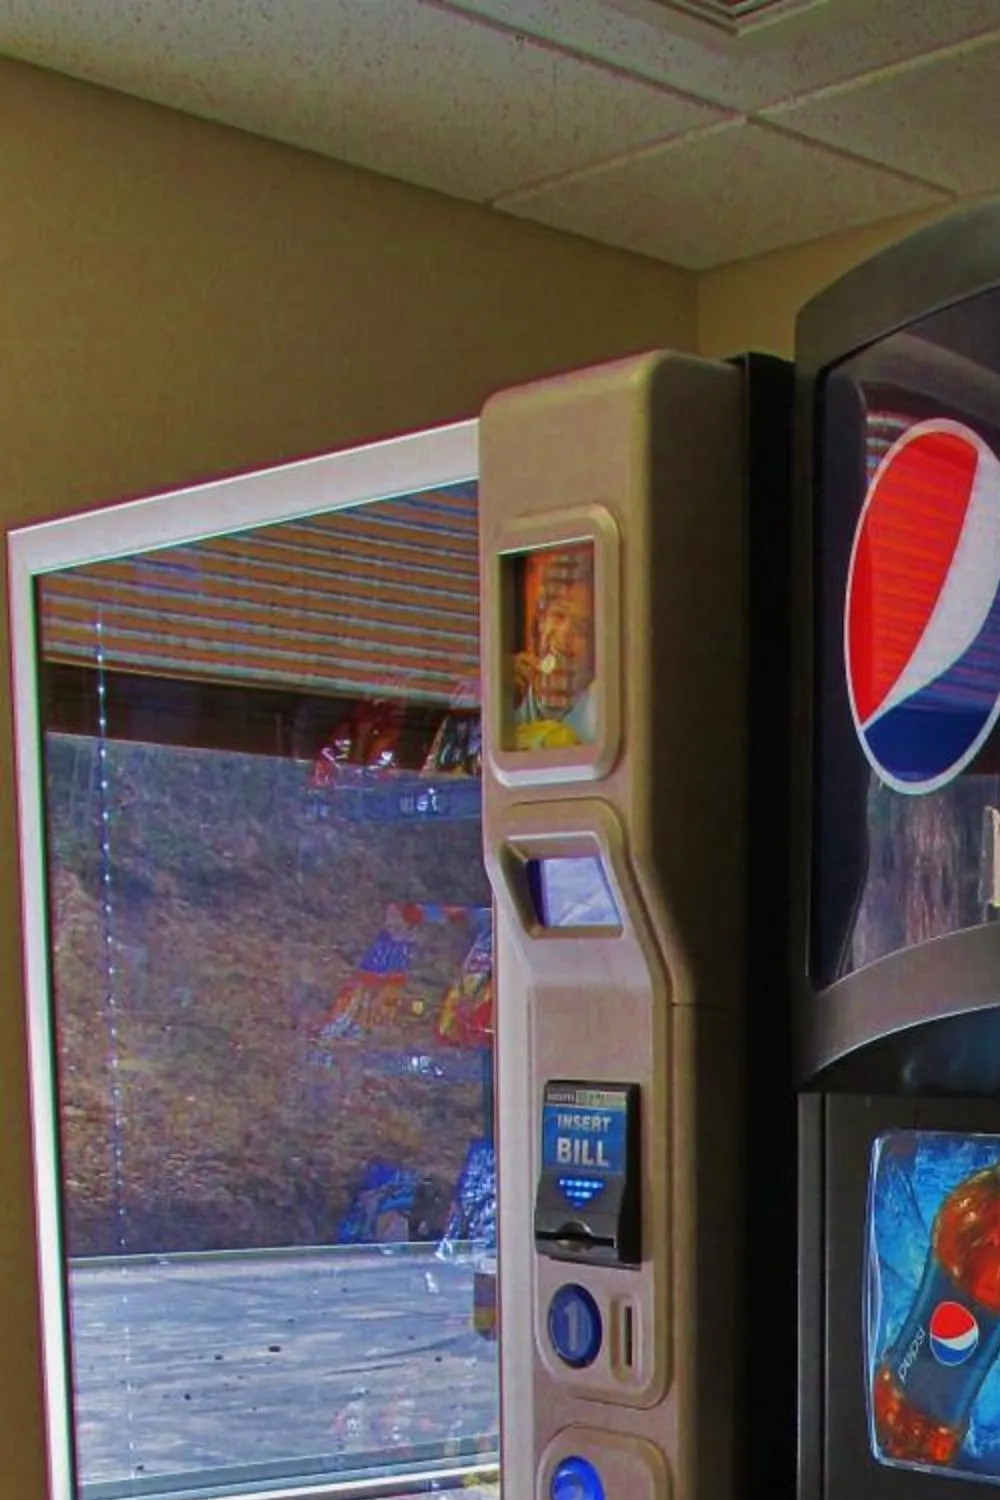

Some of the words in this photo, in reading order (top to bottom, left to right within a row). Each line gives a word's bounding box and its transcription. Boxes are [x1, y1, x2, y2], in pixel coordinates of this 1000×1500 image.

[556, 1112, 613, 1132] INSERT
[556, 1136, 612, 1166] BILL
[563, 1300, 578, 1351] 1
